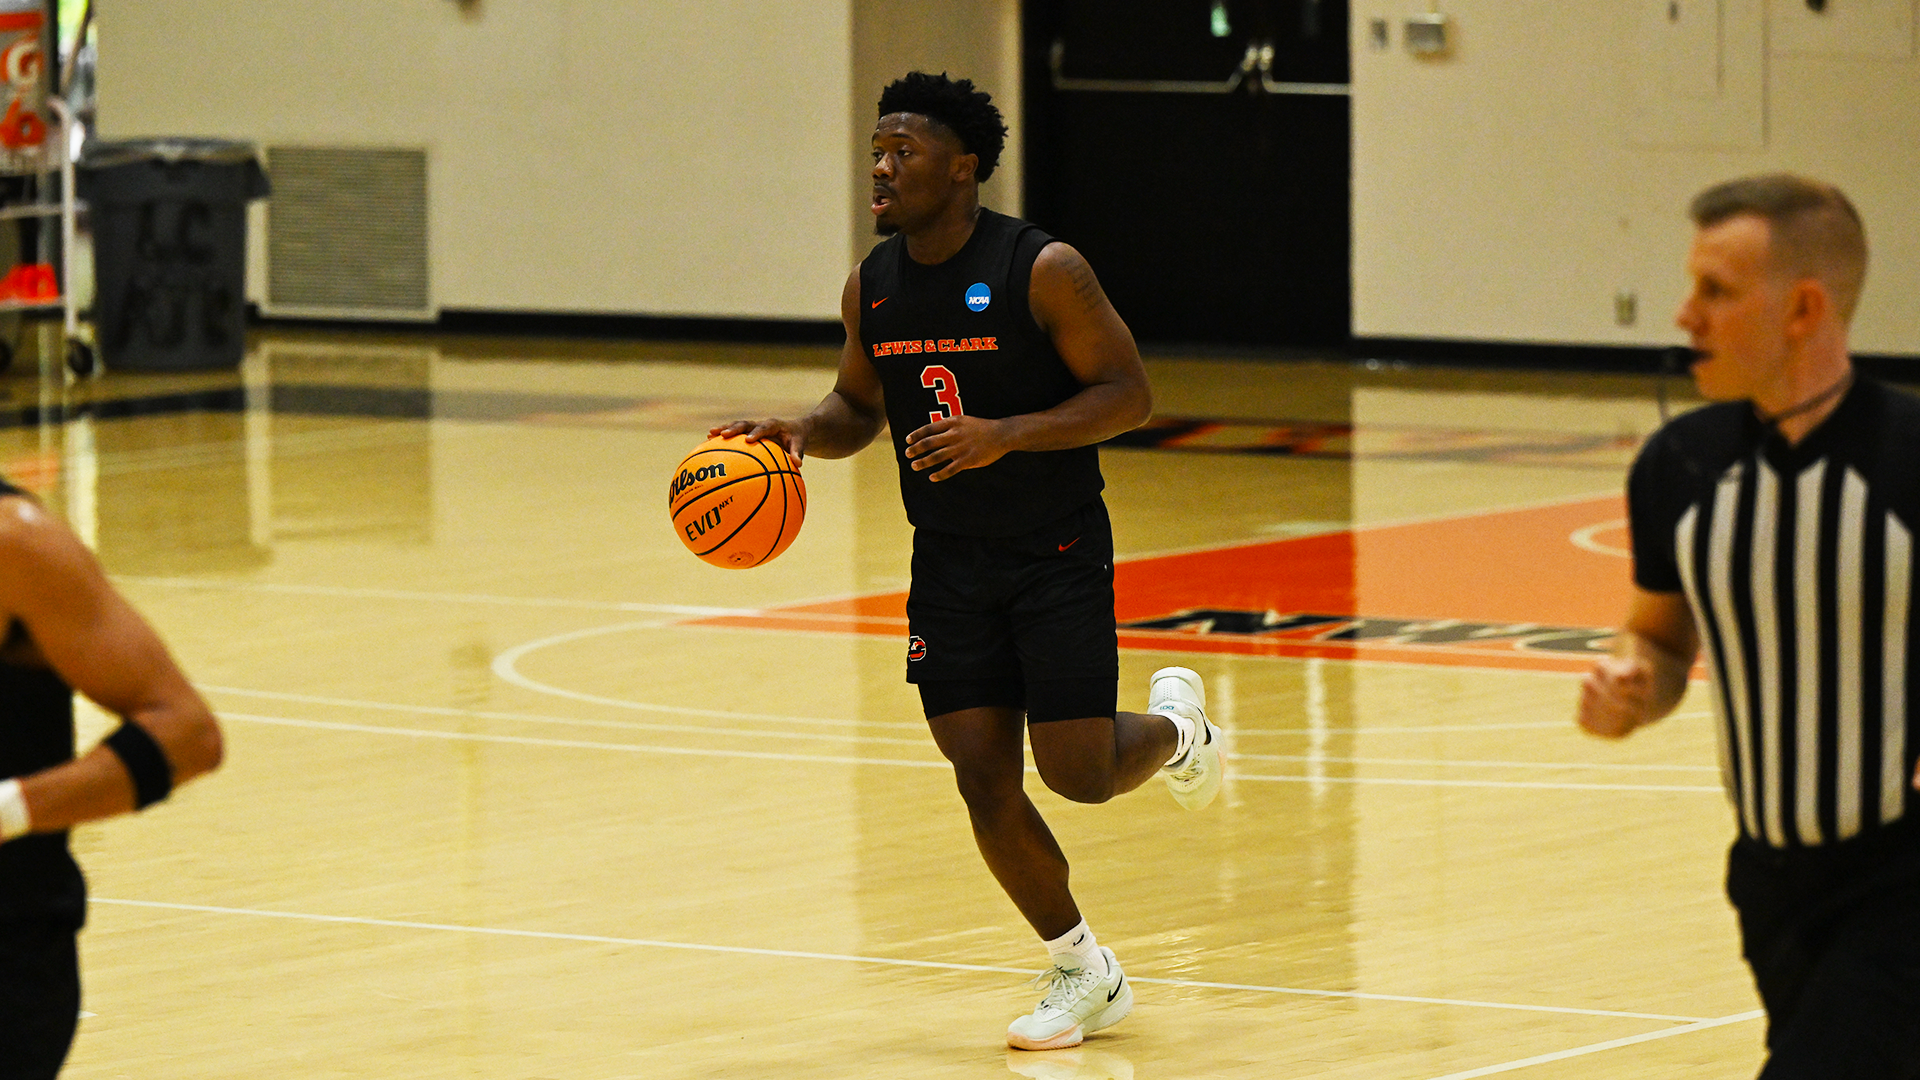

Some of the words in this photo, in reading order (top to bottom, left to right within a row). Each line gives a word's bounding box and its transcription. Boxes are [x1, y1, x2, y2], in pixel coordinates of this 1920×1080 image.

[968, 296, 990, 305] NCAA
[872, 340, 923, 357] LEWIS
[924, 339, 937, 353] &
[937, 336, 999, 353] CLARK
[920, 364, 964, 424] 3
